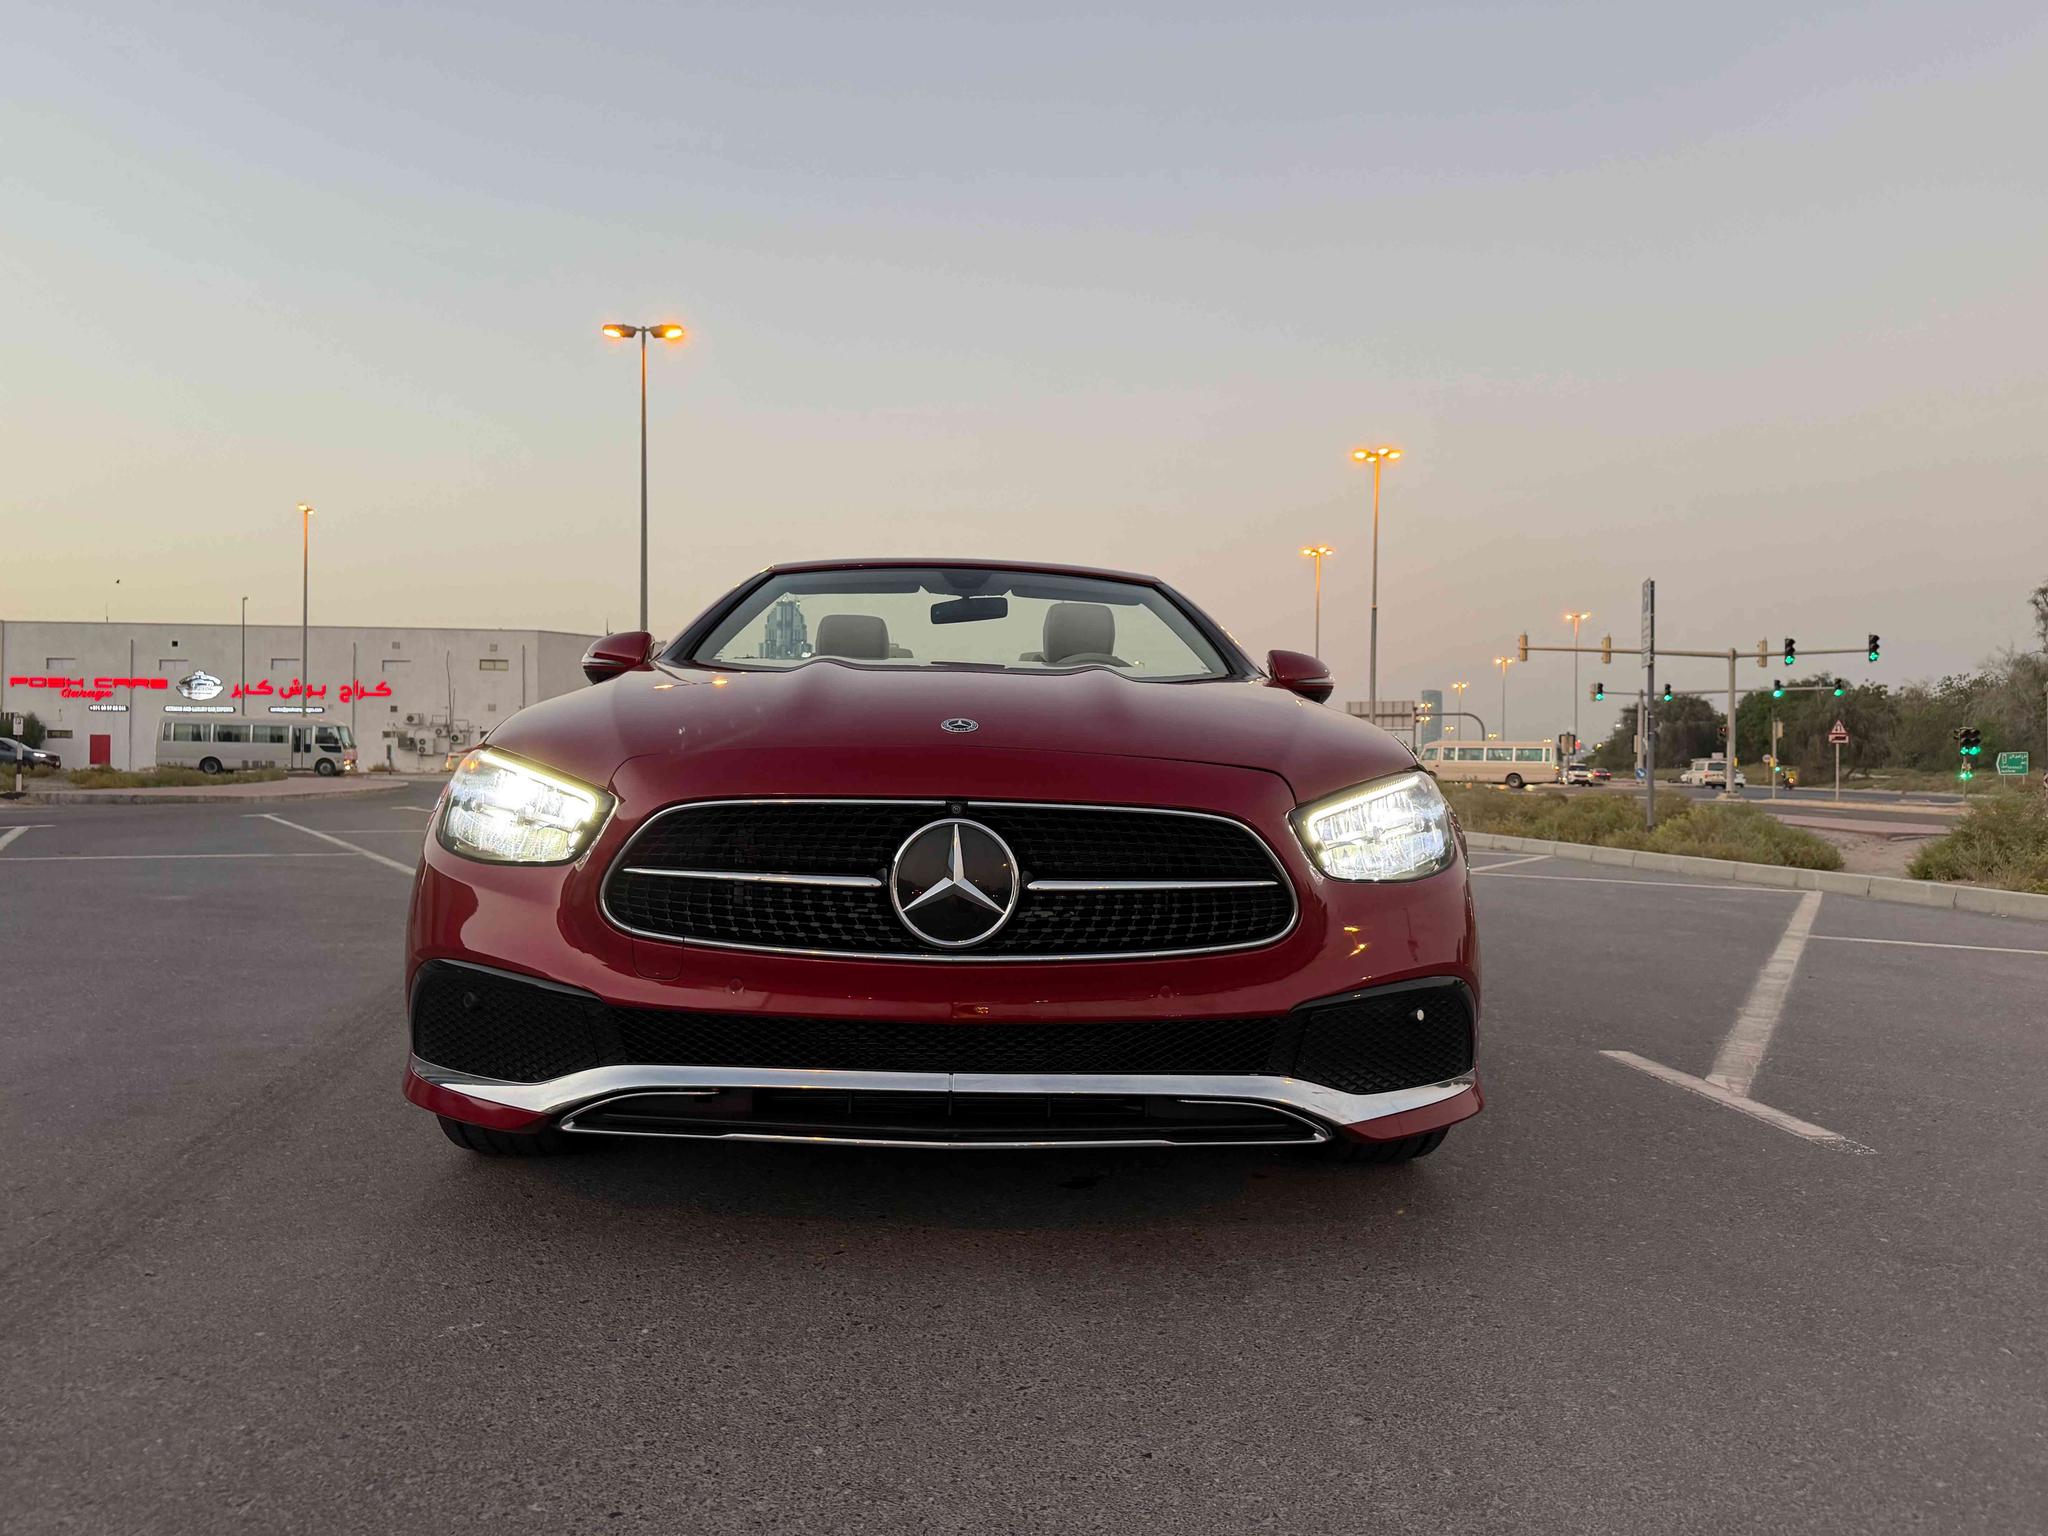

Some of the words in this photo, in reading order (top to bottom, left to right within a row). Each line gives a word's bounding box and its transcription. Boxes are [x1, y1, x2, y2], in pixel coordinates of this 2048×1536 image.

[9, 677, 84, 688] POSH
[278, 678, 326, 699] بوش
[339, 680, 392, 703] كراج
